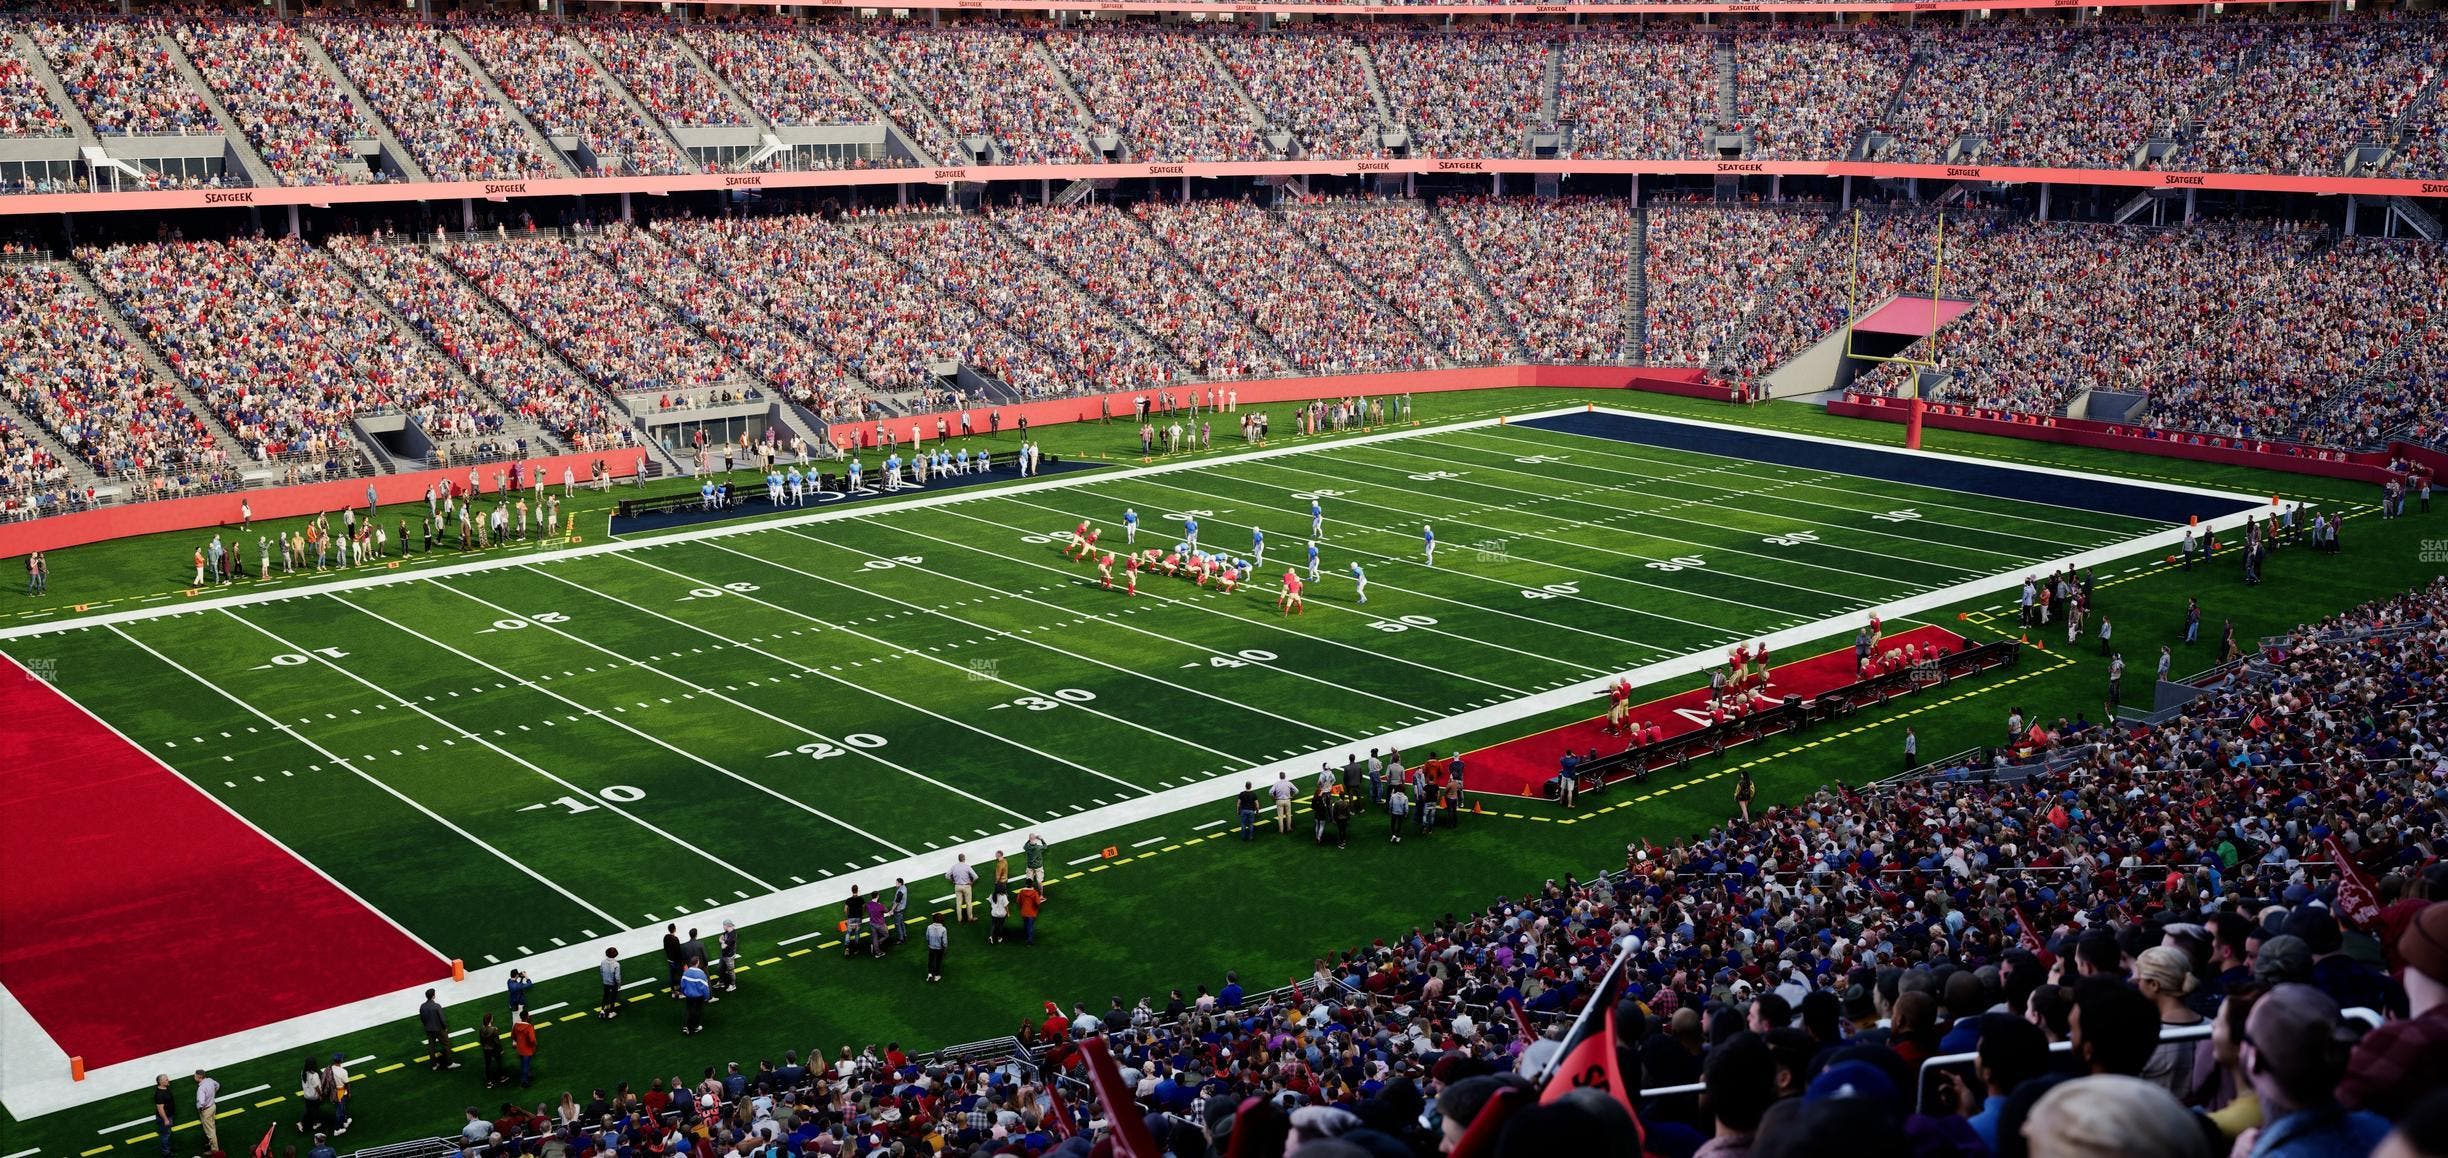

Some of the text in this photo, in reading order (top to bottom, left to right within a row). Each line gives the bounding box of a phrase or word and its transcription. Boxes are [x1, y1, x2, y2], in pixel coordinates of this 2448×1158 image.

[1149, 166, 1184, 174] SEATGEEK
[1357, 162, 1389, 171] SEATGEEK
[1438, 161, 1482, 170] SEATGEEK
[1717, 163, 1762, 172] SEATGEEK
[935, 169, 966, 179] SEATGEEK
[1946, 168, 1980, 177] SEATGEEK
[725, 175, 761, 185] SEATGEEK
[2165, 175, 2204, 185] SEATGEEK
[485, 183, 526, 194] SEATGEEK
[205, 192, 253, 203] SEATGEEK
[1872, 510, 1923, 522] 10
[1762, 533, 1820, 546] 20
[1645, 557, 1706, 572] 30
[1520, 584, 1580, 599] 40
[1366, 615, 1439, 633] 50
[1210, 649, 1279, 668] 40
[1013, 688, 1097, 711] 30
[796, 733, 888, 760] 20
[550, 785, 646, 815] 10
